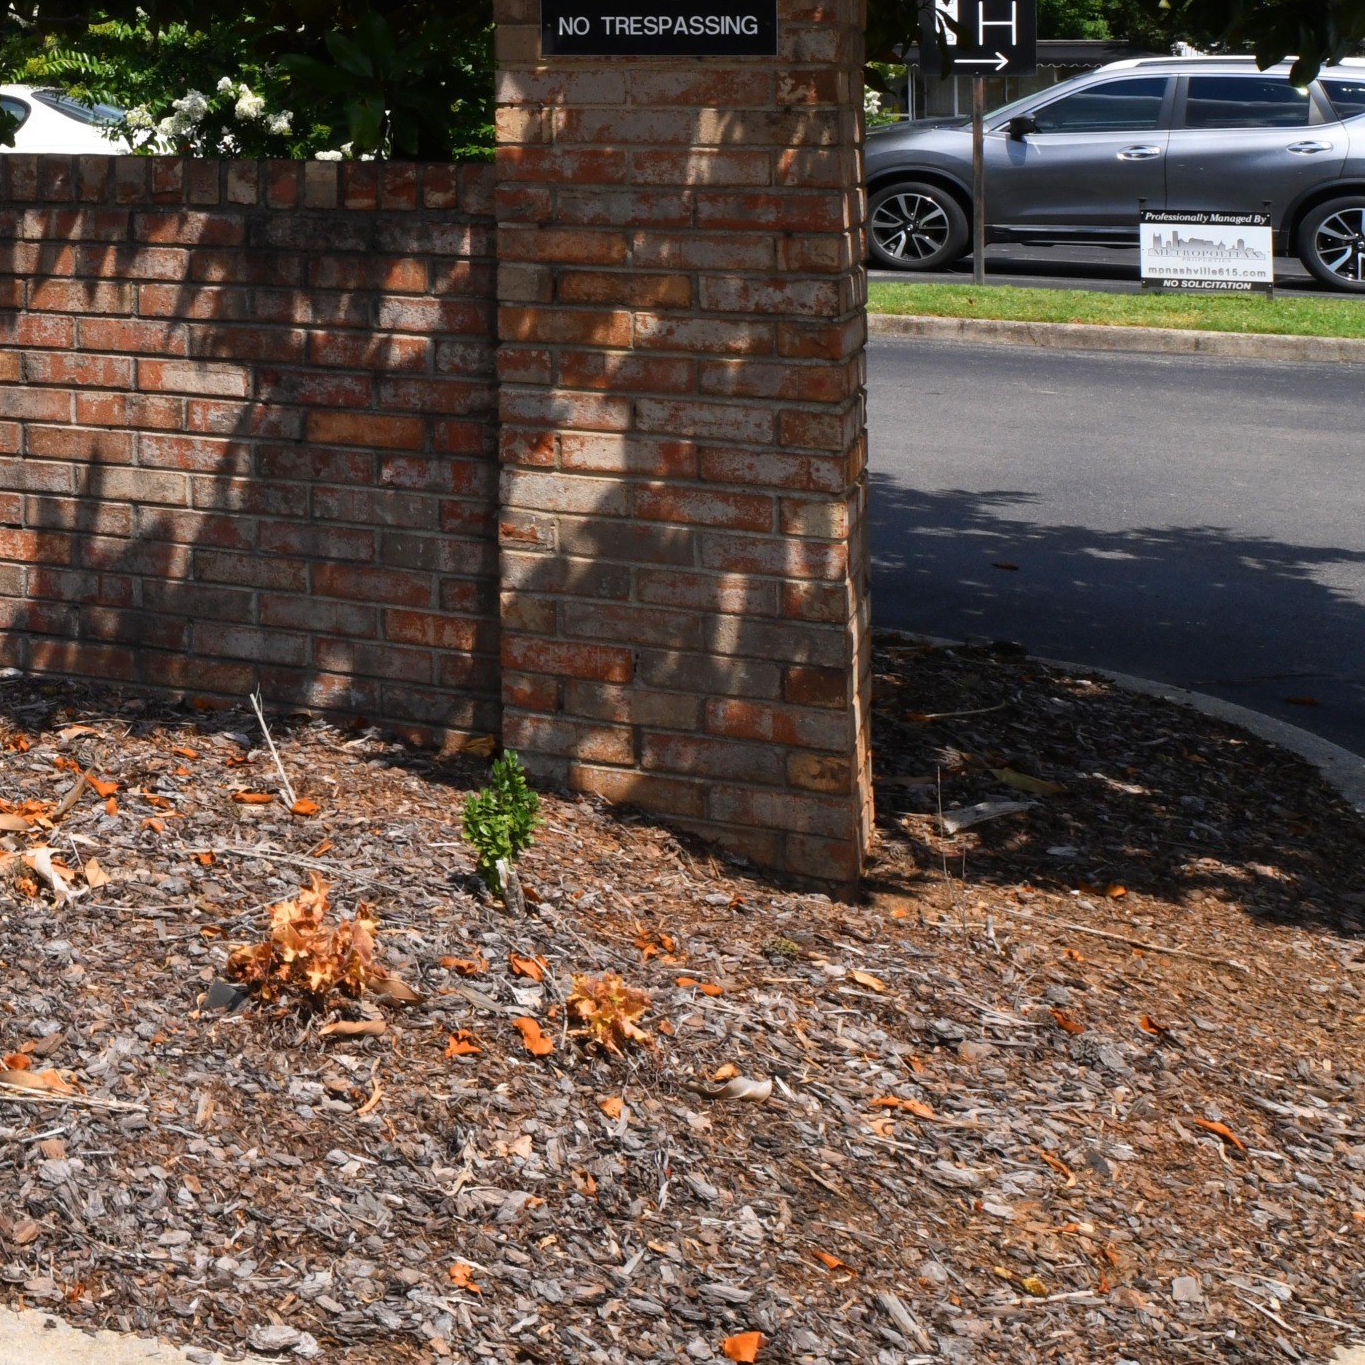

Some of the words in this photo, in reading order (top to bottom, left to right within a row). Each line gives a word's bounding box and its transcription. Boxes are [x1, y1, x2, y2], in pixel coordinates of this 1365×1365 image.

[558, 16, 590, 36] NO
[600, 15, 758, 35] TRESPASSING
[978, 0, 1017, 46] H
[1145, 212, 1209, 224] Professionally
[1209, 214, 1252, 225] Managed
[1253, 214, 1267, 225] By
[1148, 266, 1267, 278] mpnashville615.com
[1162, 279, 1180, 288] NO
[1180, 280, 1252, 290] SOLICITATION
